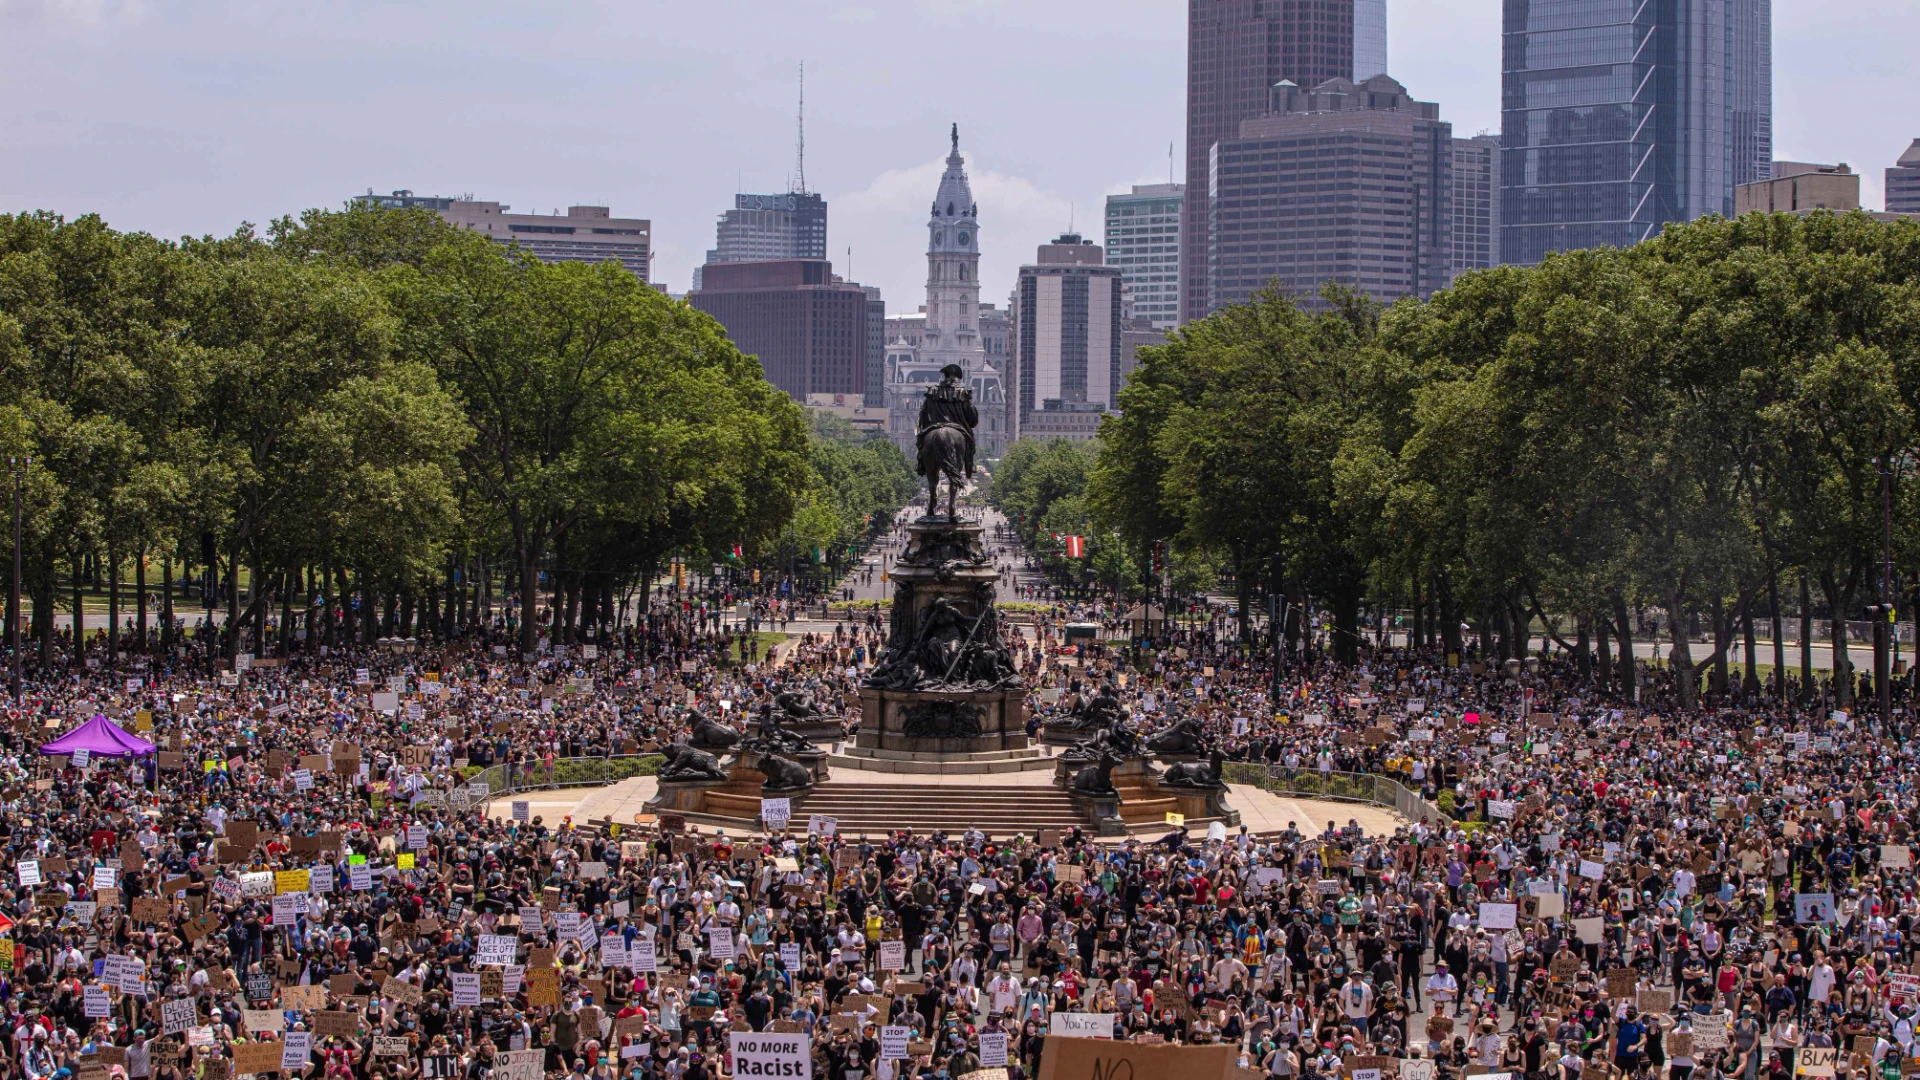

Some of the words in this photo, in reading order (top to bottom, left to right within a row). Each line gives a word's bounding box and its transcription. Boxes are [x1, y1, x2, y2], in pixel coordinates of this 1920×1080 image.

[405, 748, 432, 765] BLM
[216, 882, 236, 892] LIVES
[218, 877, 237, 888] BLACK
[214, 888, 233, 898] MATTER
[480, 936, 496, 944] GET
[478, 945, 498, 953] KNEE
[500, 945, 515, 953] OFF
[498, 954, 516, 964] NECK
[121, 968, 143, 976] Racist
[265, 959, 298, 985] BLM
[528, 968, 554, 977] MAKE
[532, 980, 558, 991] MLK
[384, 987, 404, 998] GEORGE
[1544, 990, 1572, 1009] BLM
[164, 1000, 193, 1011] BLACK
[165, 1008, 195, 1023] LIVES
[165, 1017, 196, 1032] MATTER
[1062, 1014, 1099, 1030] You're
[375, 1037, 408, 1046] JUSTICE
[737, 1041, 757, 1052] NO
[760, 1042, 799, 1054] MORE
[150, 1056, 178, 1066] POLICE
[494, 1054, 510, 1067] NO
[511, 1050, 544, 1064] JUSTICE
[1801, 1049, 1834, 1066] BLM
[422, 1056, 458, 1078] BLM
[494, 1071, 510, 1080] NO
[512, 1062, 544, 1080] PEACE
[736, 1057, 804, 1077] Racist
[1092, 1057, 1134, 1080] NO
[1410, 1070, 1426, 1080] BLM
